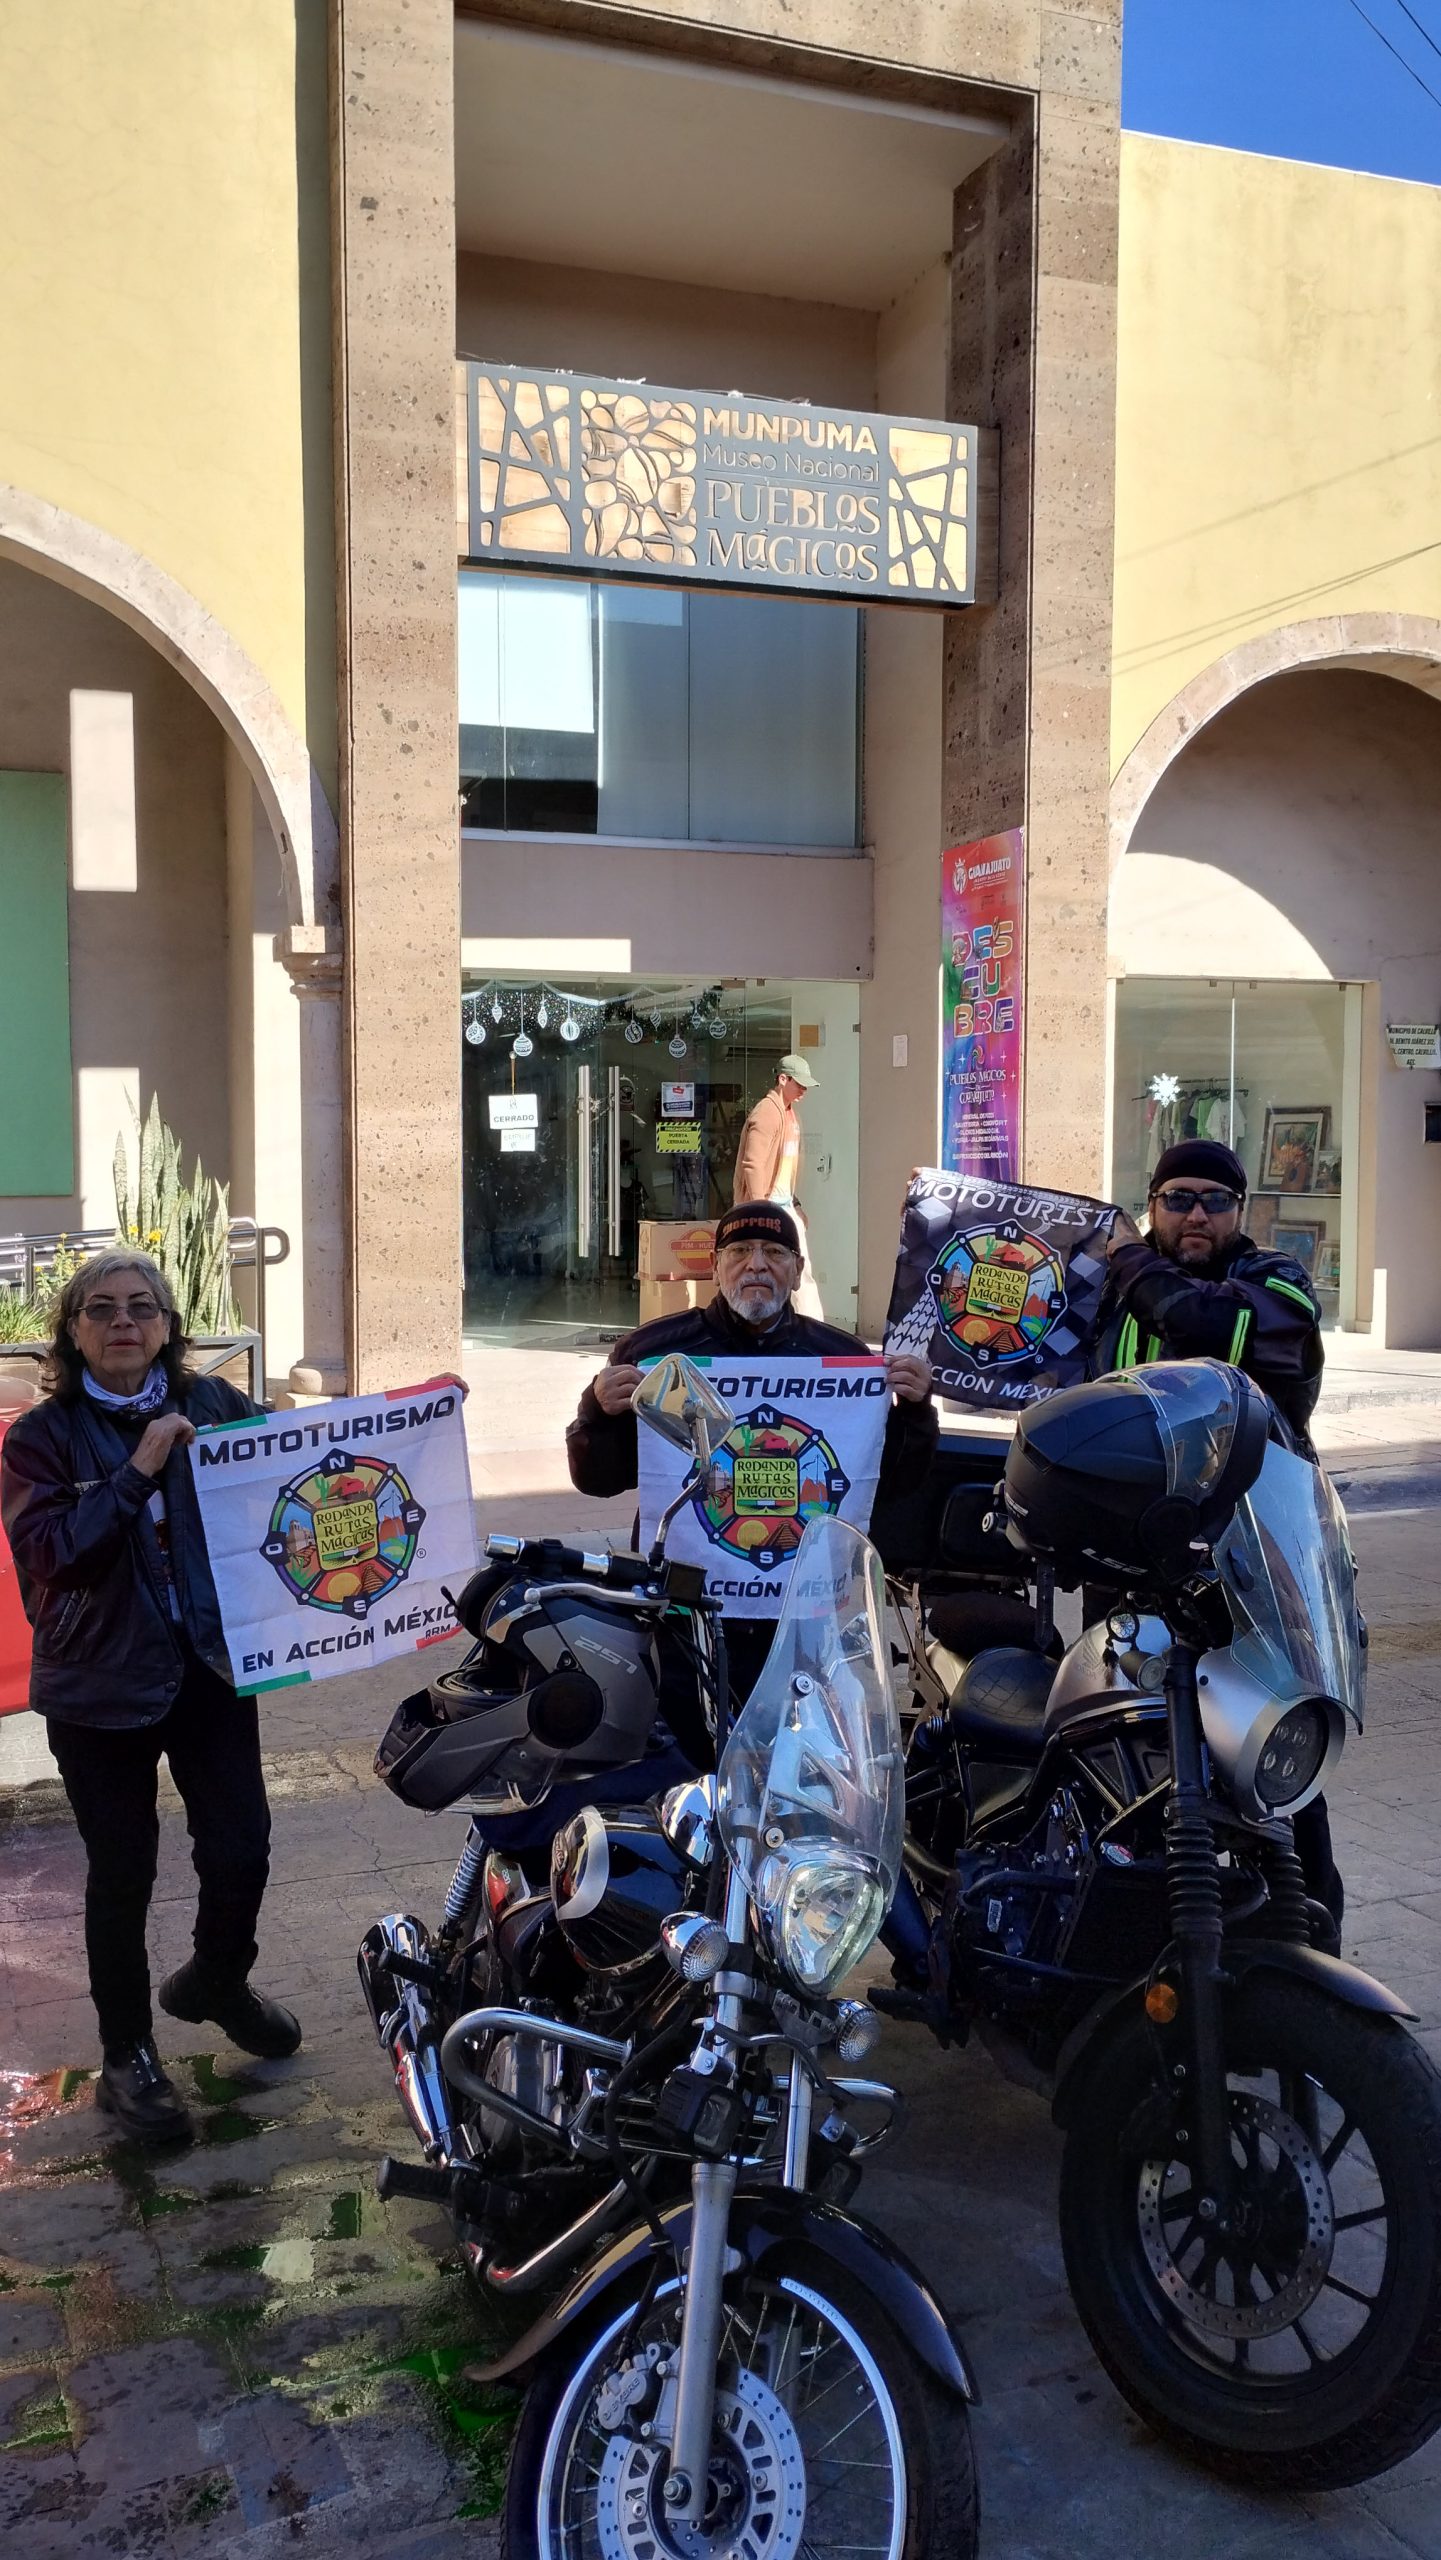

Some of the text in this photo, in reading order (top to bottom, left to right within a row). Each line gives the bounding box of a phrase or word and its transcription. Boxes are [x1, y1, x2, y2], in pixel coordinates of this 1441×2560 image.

[703, 407, 878, 455] MUNPUMA
[703, 442, 880, 483] Museo Nacional
[953, 996, 1015, 1038] BRE
[493, 1114, 535, 1123] CERRADO
[1003, 1226, 1018, 1239] N
[975, 1264, 1027, 1285] RODANDO
[977, 1277, 1020, 1296] RUTAS
[977, 1350, 990, 1362] S
[930, 1365, 995, 1394] CCIÓN
[706, 1376, 887, 1399] OTURISMO
[757, 1411, 774, 1424] N
[199, 1394, 456, 1467] MOTOTURISMO
[328, 1455, 346, 1470] N
[737, 1460, 796, 1472] RODANDO
[742, 1472, 791, 1485] RUTAS
[831, 1479, 844, 1492] E
[315, 1502, 374, 1526] RODANDO
[405, 1509, 420, 1523] E
[323, 1516, 372, 1538] RUTAS
[265, 1542, 284, 1556] O
[759, 1551, 774, 1565] S
[353, 1599, 368, 1613] S
[241, 1603, 456, 1674] EN ACCIÓN MÉXIC
